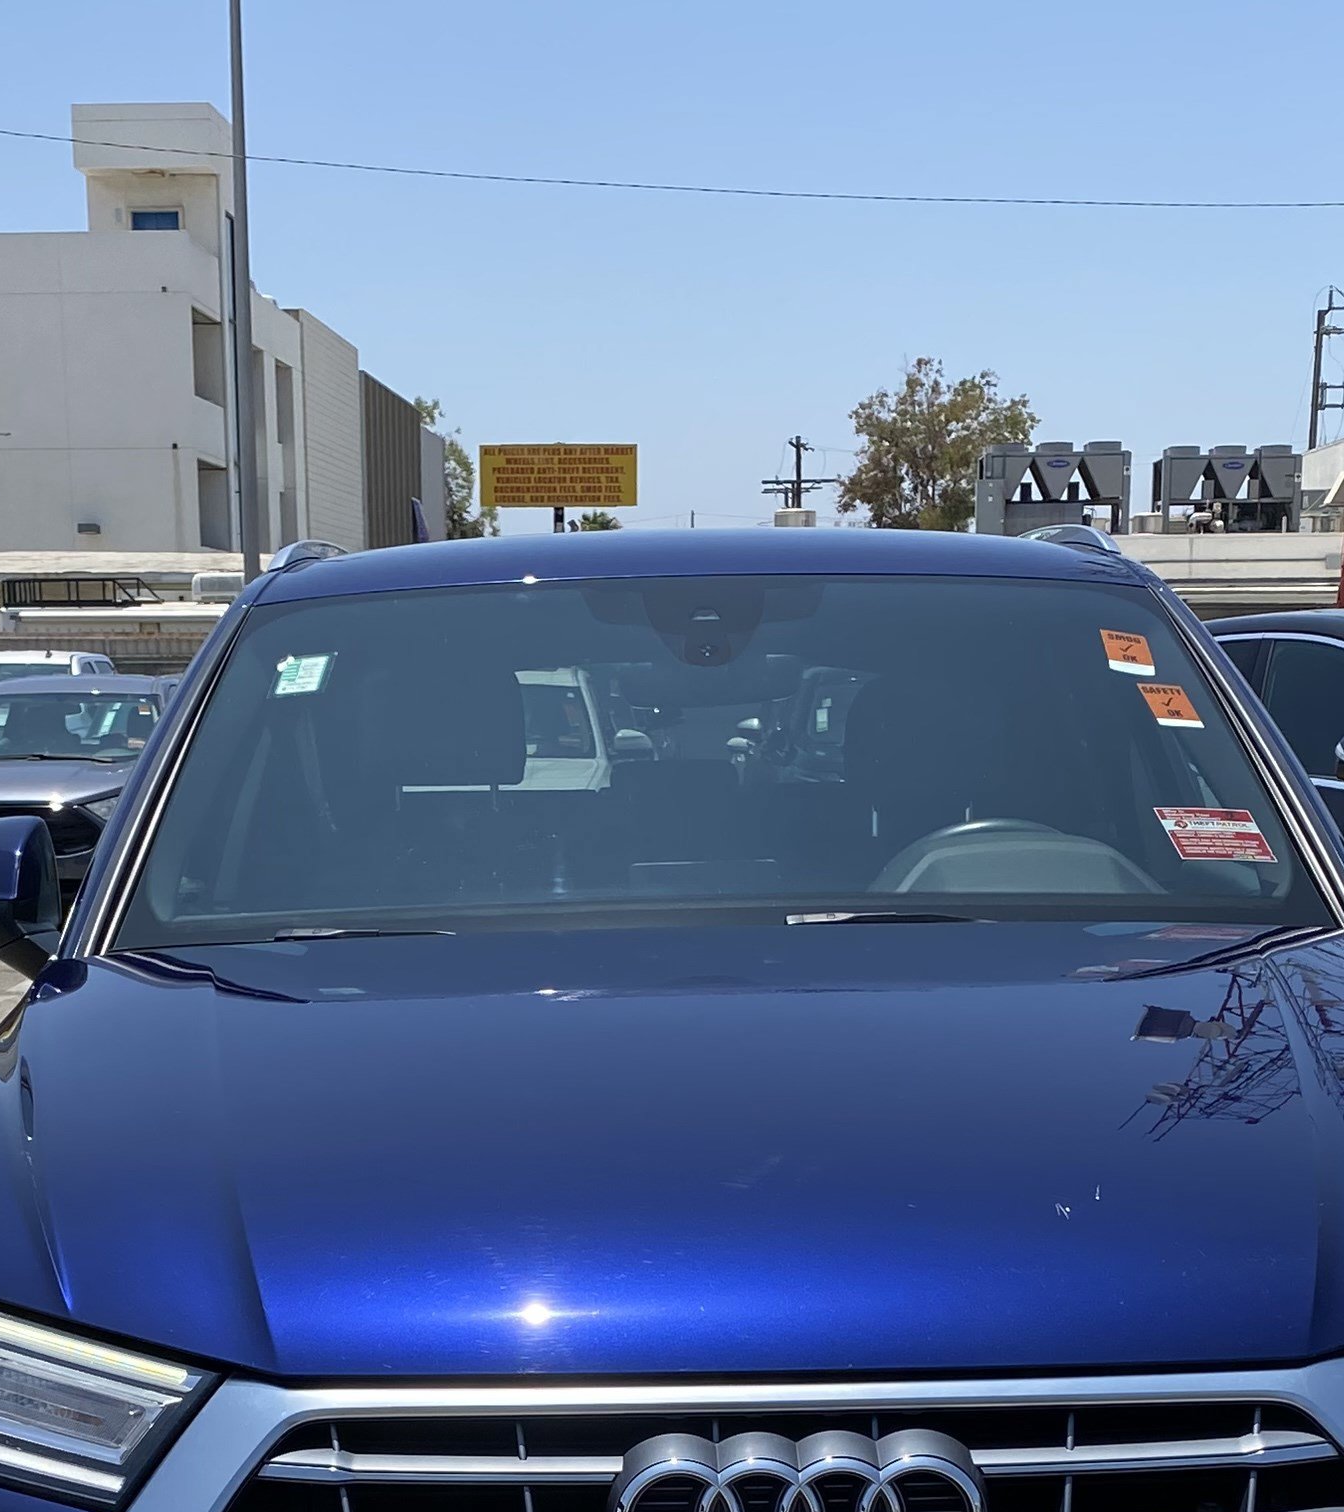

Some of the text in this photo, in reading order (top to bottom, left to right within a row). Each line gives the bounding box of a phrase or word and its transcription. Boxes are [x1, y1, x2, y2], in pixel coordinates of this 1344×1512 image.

[1107, 632, 1142, 644] SMOG
[1122, 653, 1138, 662] OK
[1141, 685, 1182, 696] SAFETY
[1166, 709, 1184, 718] OK
